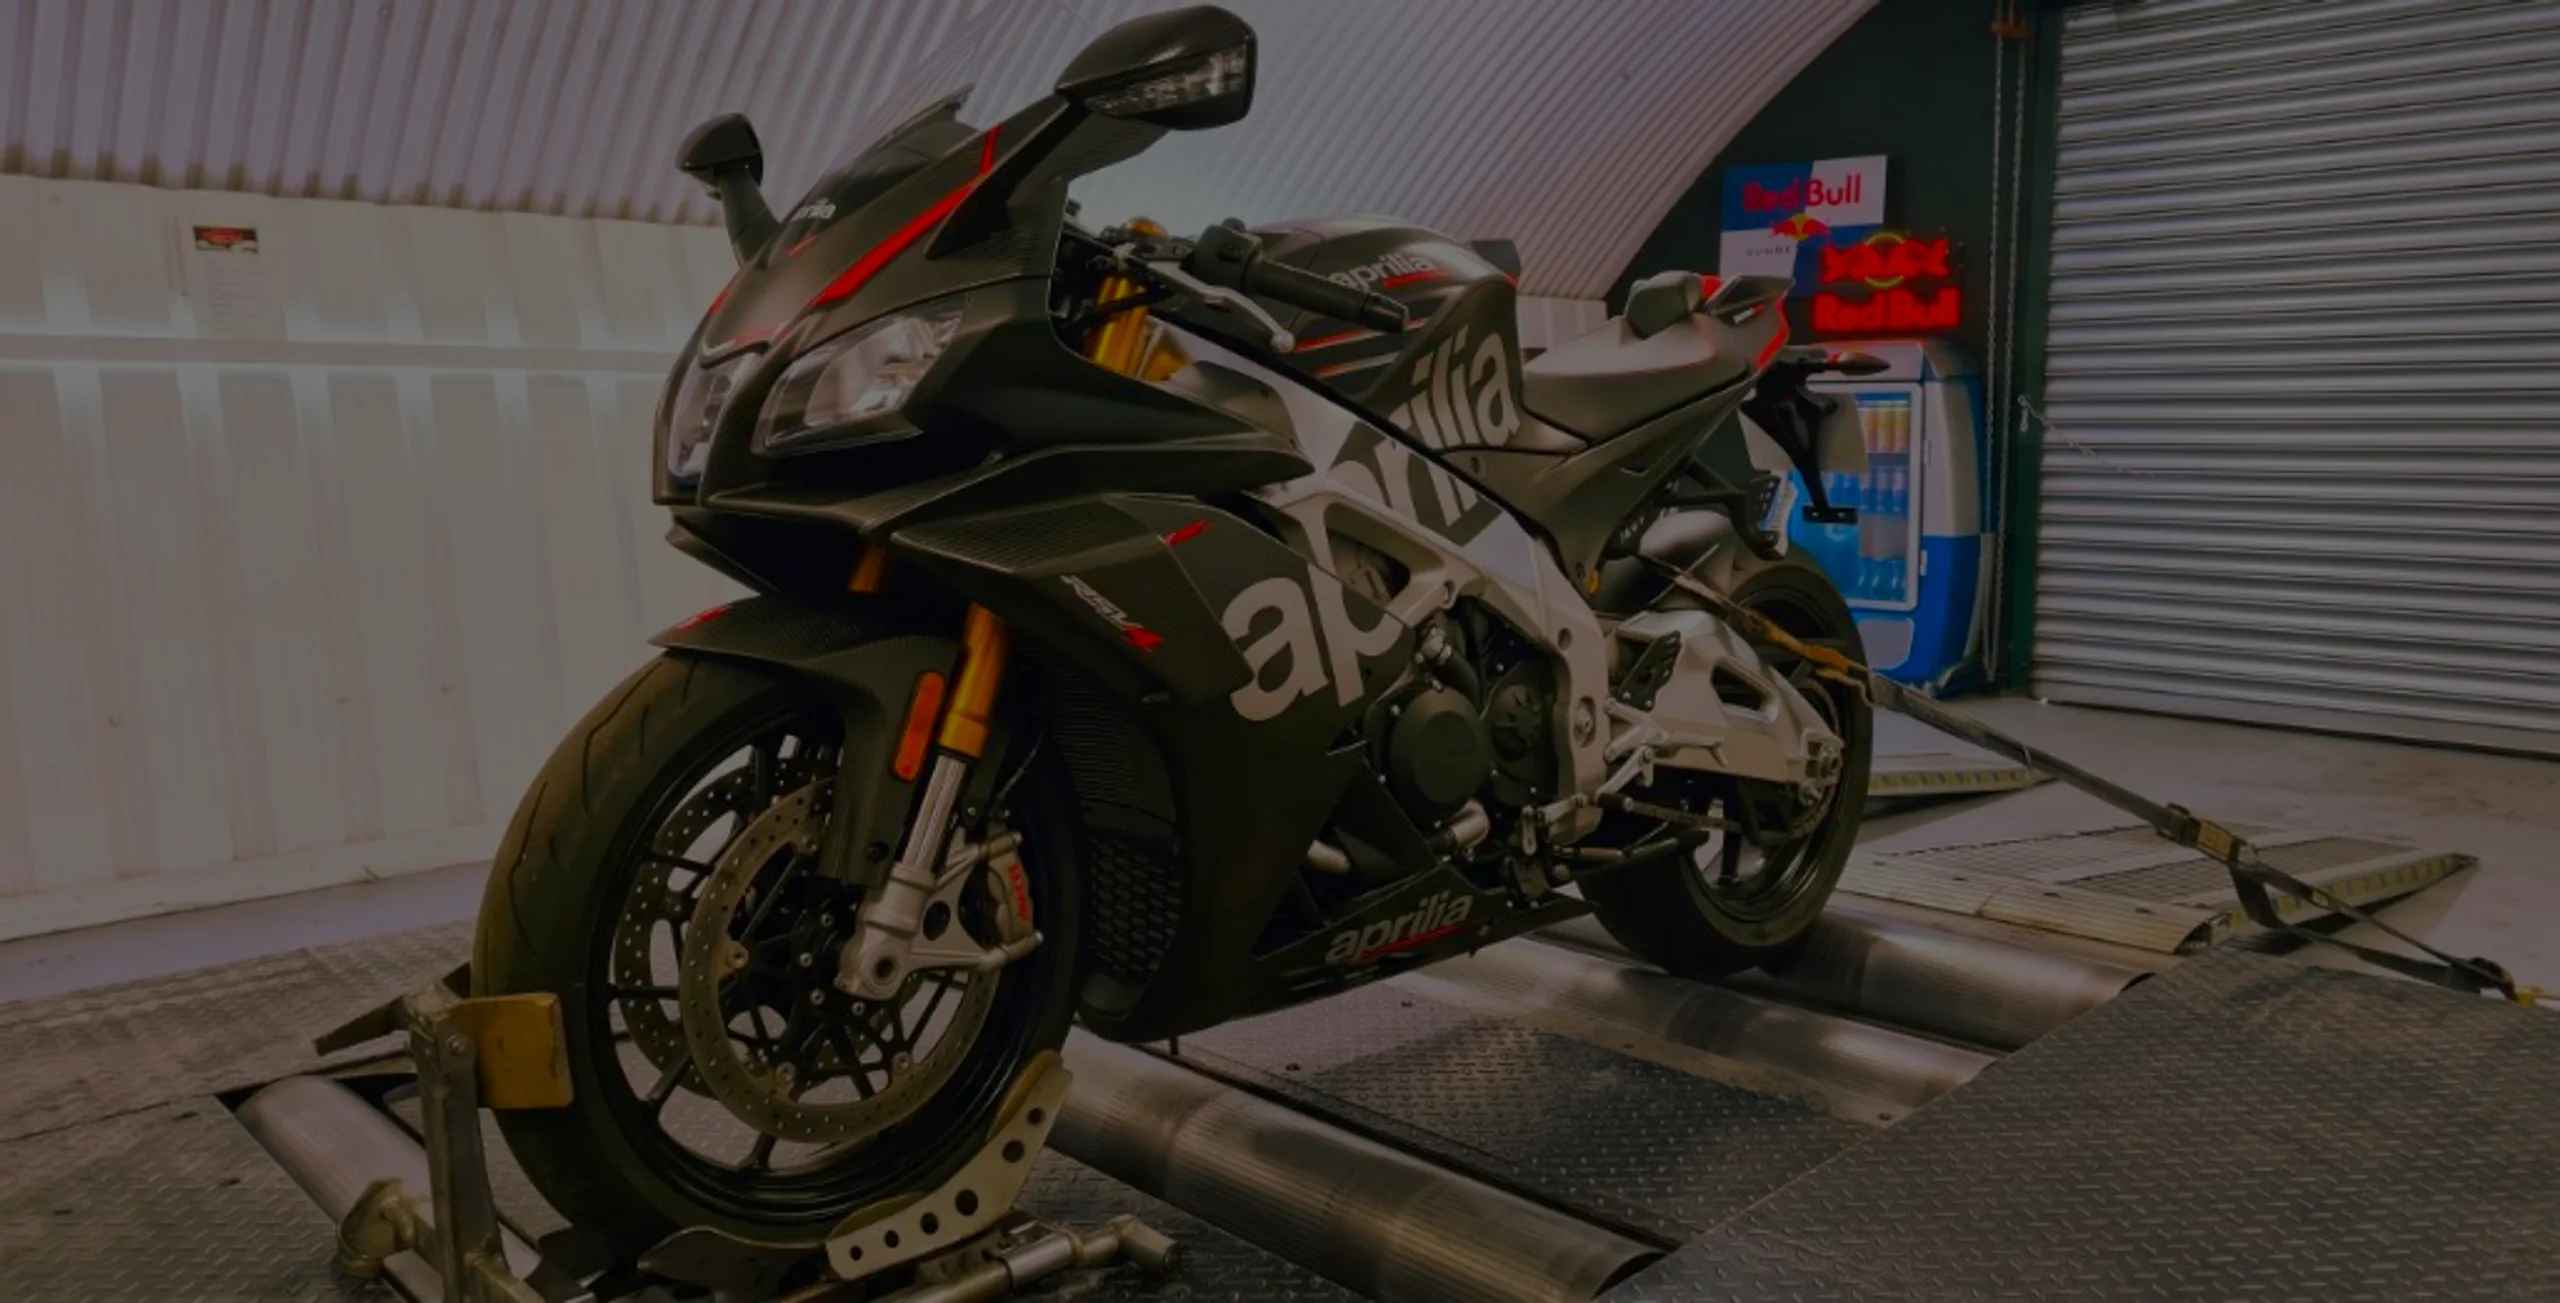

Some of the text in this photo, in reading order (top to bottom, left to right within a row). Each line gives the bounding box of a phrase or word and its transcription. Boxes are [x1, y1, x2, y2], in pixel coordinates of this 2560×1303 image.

[1743, 173, 1861, 213] Red Bull
[1329, 253, 1435, 293] aprilia
[1813, 285, 1961, 333] Red Bull
[1222, 326, 1521, 722] aprilia
[1325, 889, 1474, 968] aprilia
